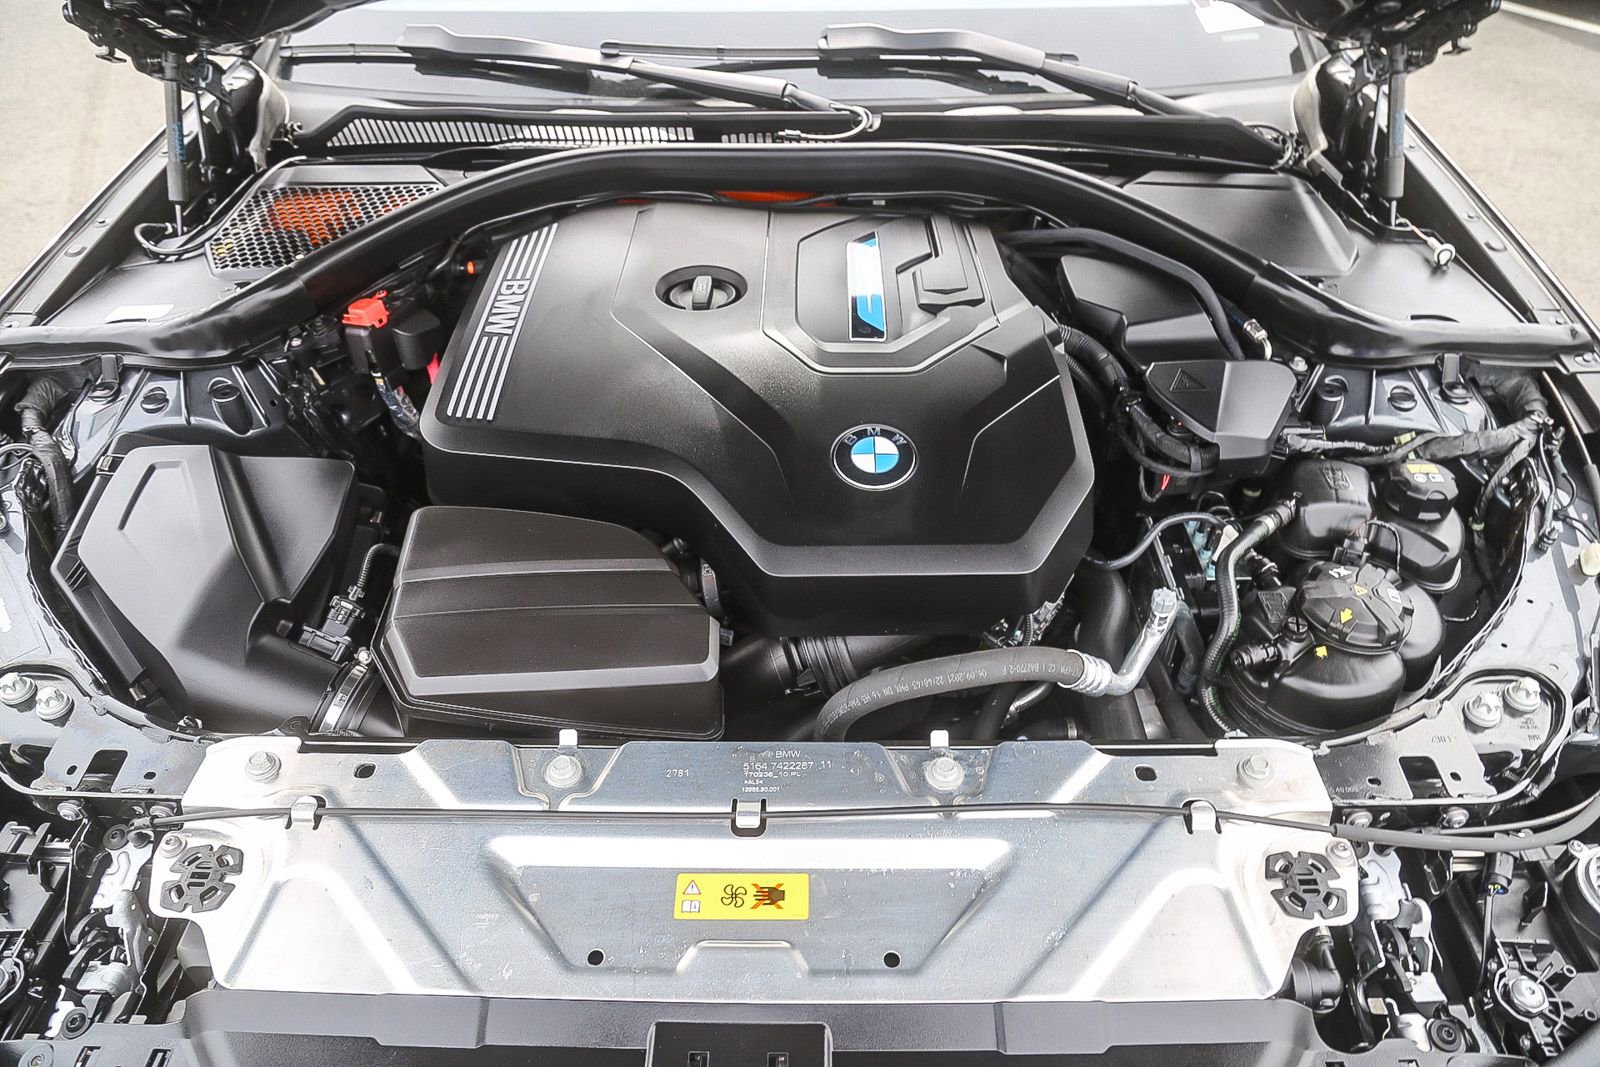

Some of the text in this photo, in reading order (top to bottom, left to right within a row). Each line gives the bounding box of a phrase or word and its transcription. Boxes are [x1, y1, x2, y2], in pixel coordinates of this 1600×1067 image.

[484, 280, 531, 335] BMW
[843, 426, 908, 446] BMW
[947, 668, 987, 685] 06.09.2021
[775, 750, 801, 759] BMW
[666, 767, 689, 778] 2781
[743, 761, 768, 770] 5164
[771, 761, 814, 770] 7422287
